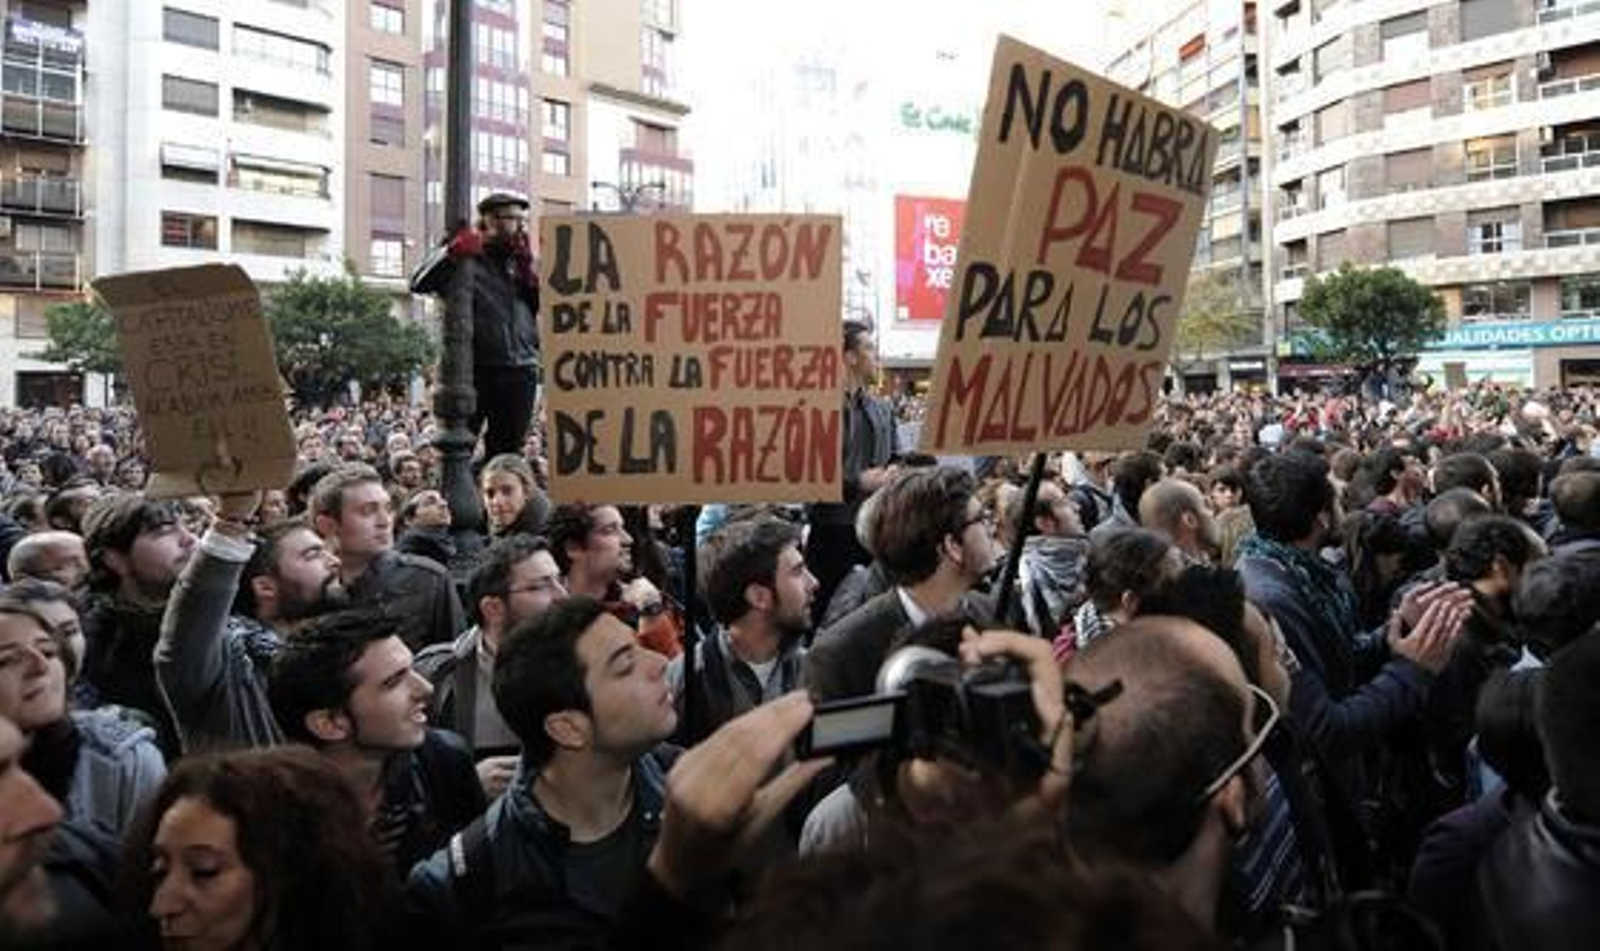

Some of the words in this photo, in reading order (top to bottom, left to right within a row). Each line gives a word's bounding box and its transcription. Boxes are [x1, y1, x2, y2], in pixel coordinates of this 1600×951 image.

[998, 63, 1088, 154] NO
[1096, 94, 1207, 194] HABRA
[549, 222, 620, 295] LA
[655, 219, 831, 284] RAZÓN
[1037, 166, 1184, 286] PAZ
[552, 302, 592, 333] DE
[602, 302, 631, 334] LA
[645, 293, 782, 343] FUERZA
[955, 262, 1074, 342] PARA
[1089, 285, 1172, 350] LOS
[554, 351, 654, 391] CONTRA
[669, 354, 702, 388] LA
[708, 345, 837, 391] FUERZA
[934, 350, 1161, 448] MALVADOS
[554, 409, 605, 475] DE
[618, 407, 676, 473] LA
[693, 399, 839, 485] RAZÓN
